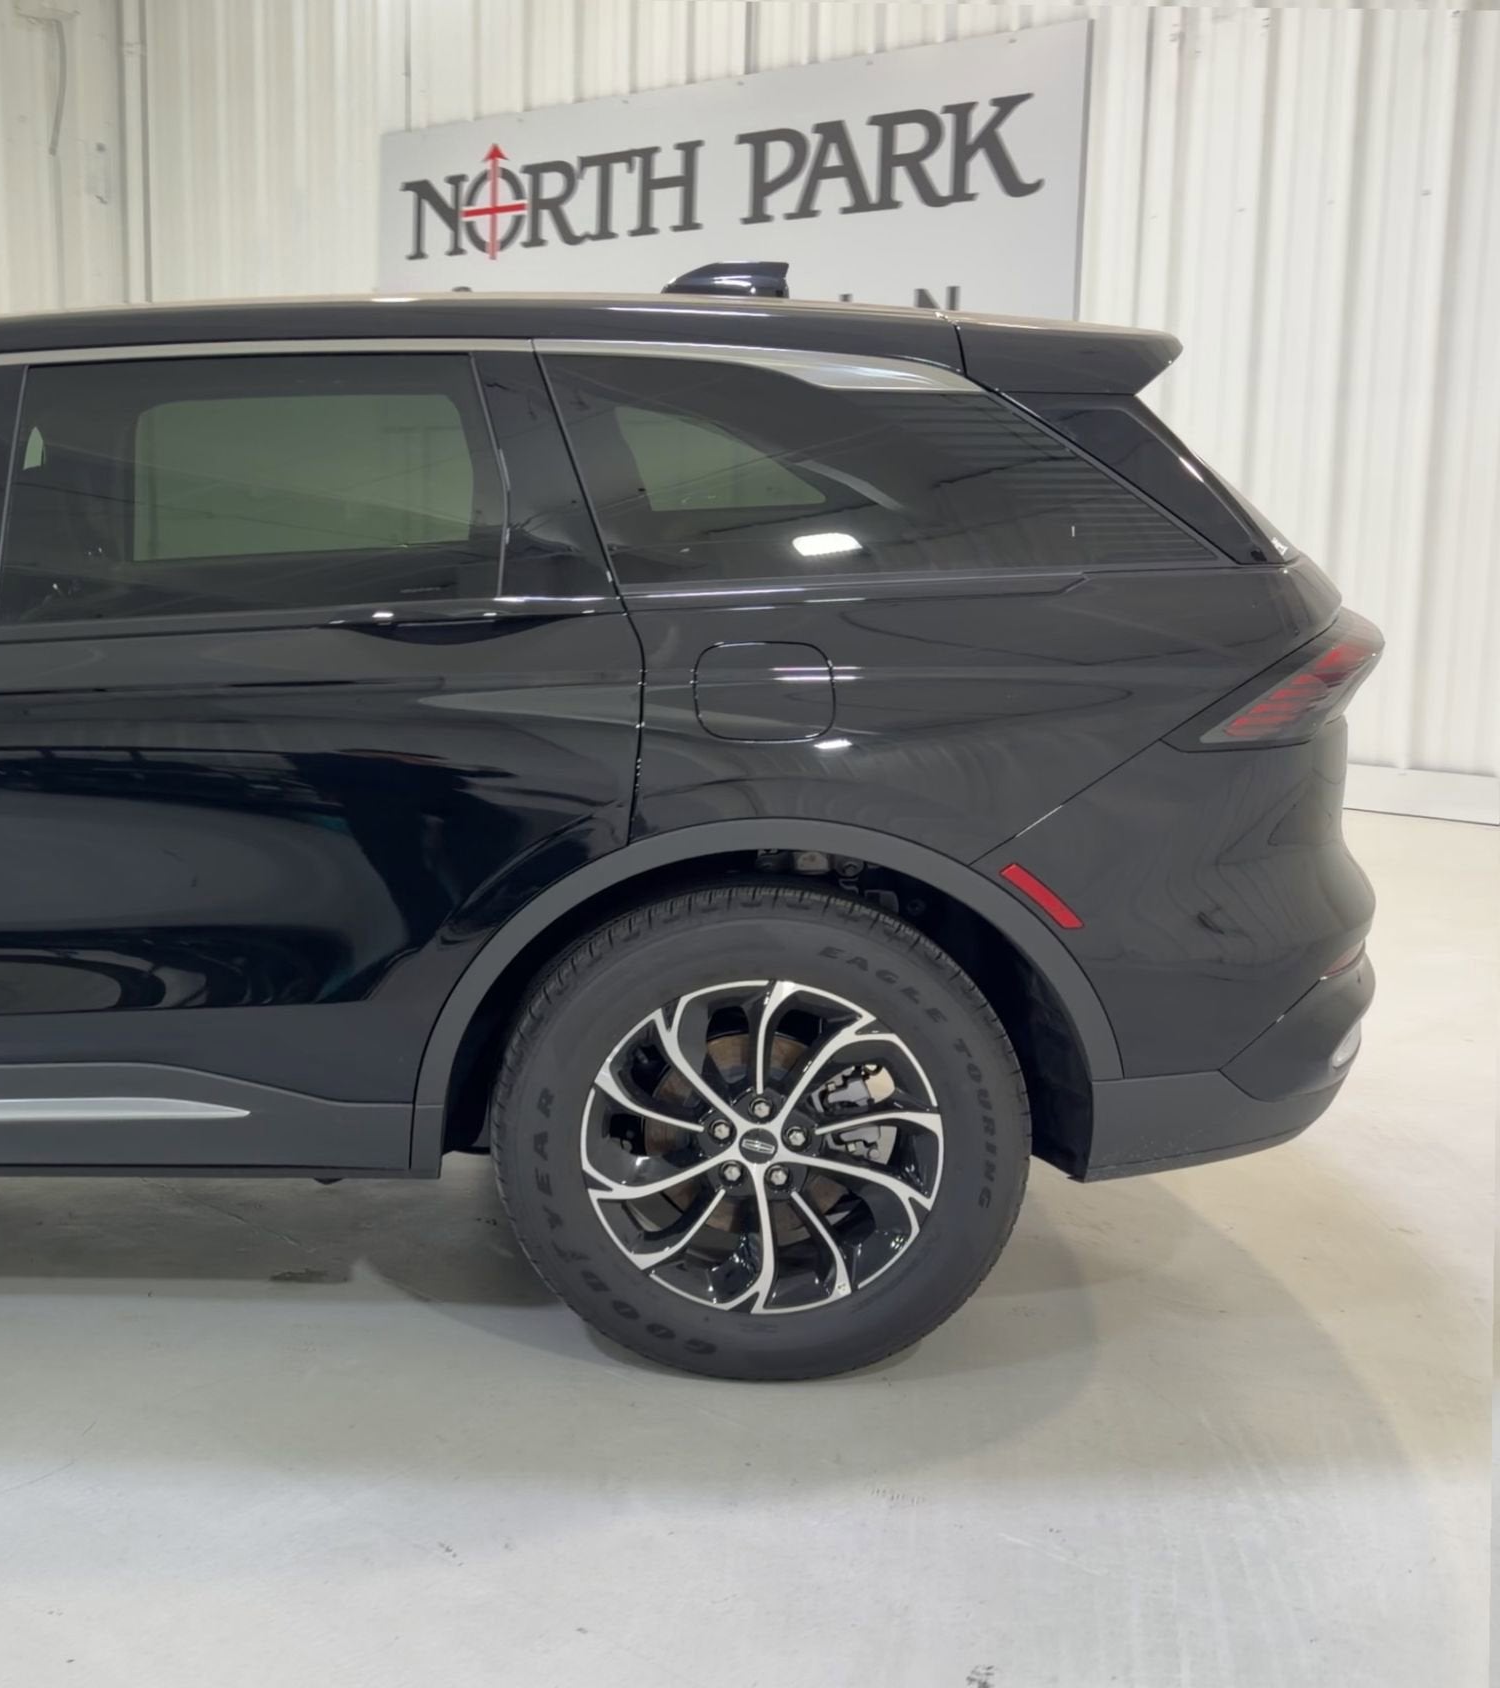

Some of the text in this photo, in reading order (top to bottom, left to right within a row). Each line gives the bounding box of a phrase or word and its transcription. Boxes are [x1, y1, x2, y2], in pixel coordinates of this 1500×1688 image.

[401, 92, 1046, 261] NORTH PARK
[817, 945, 997, 1210] EAGLE TOURING
